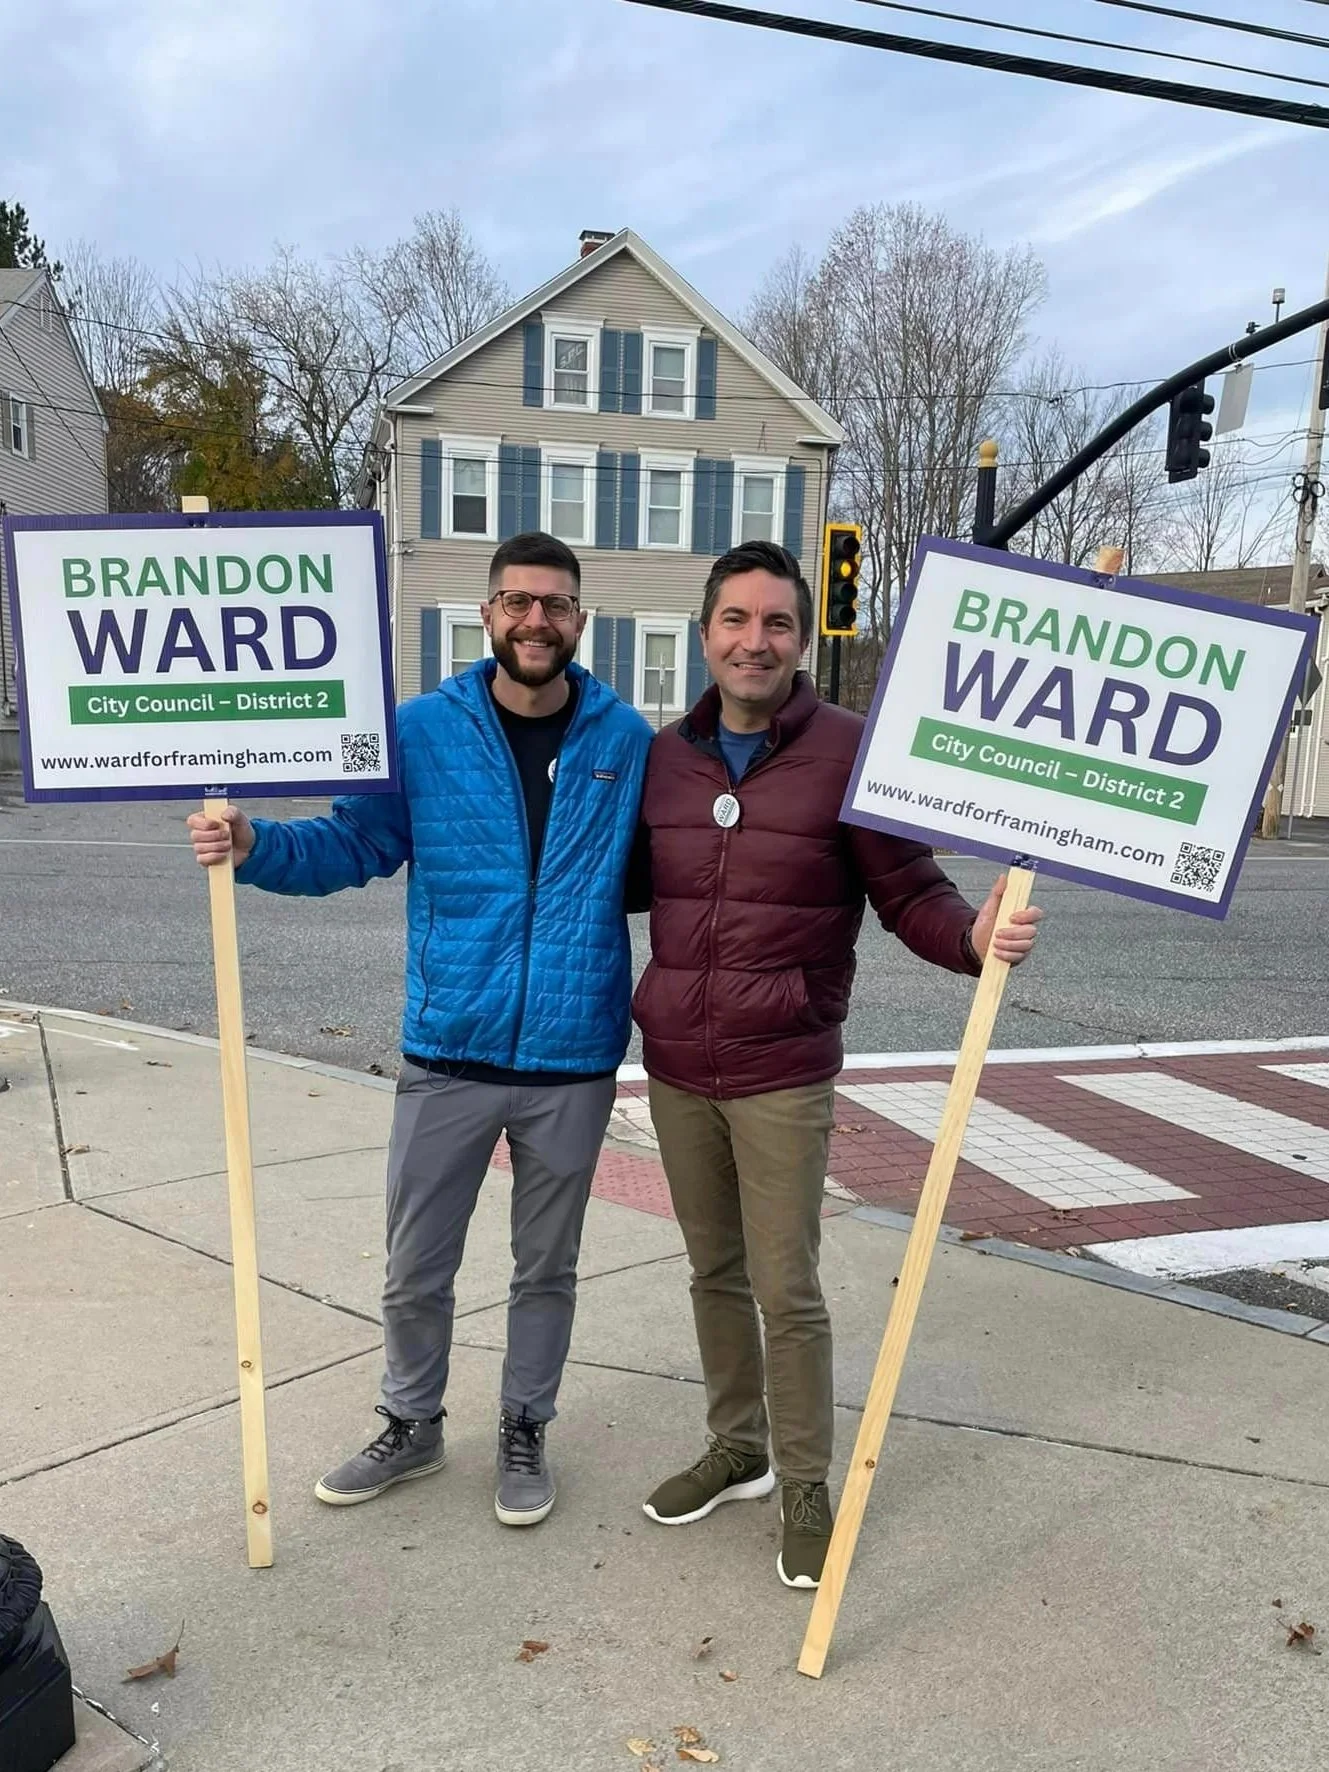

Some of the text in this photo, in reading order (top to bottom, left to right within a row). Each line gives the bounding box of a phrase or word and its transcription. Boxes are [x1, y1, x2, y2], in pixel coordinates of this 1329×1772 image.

[62, 553, 334, 598] BRANDON
[66, 605, 338, 675] WARD
[952, 589, 1247, 692] BRANDON
[87, 694, 130, 718] City
[134, 693, 215, 715] Council
[236, 691, 313, 711] District
[316, 691, 329, 709] 2
[942, 640, 1222, 767] WARD
[40, 748, 333, 771] www.wardforframingham.com
[930, 732, 976, 764] City
[978, 744, 1061, 781] Council
[1082, 769, 1167, 808] District
[1168, 788, 1185, 810] 2
[866, 779, 1165, 867] www.wardforframingham.com
